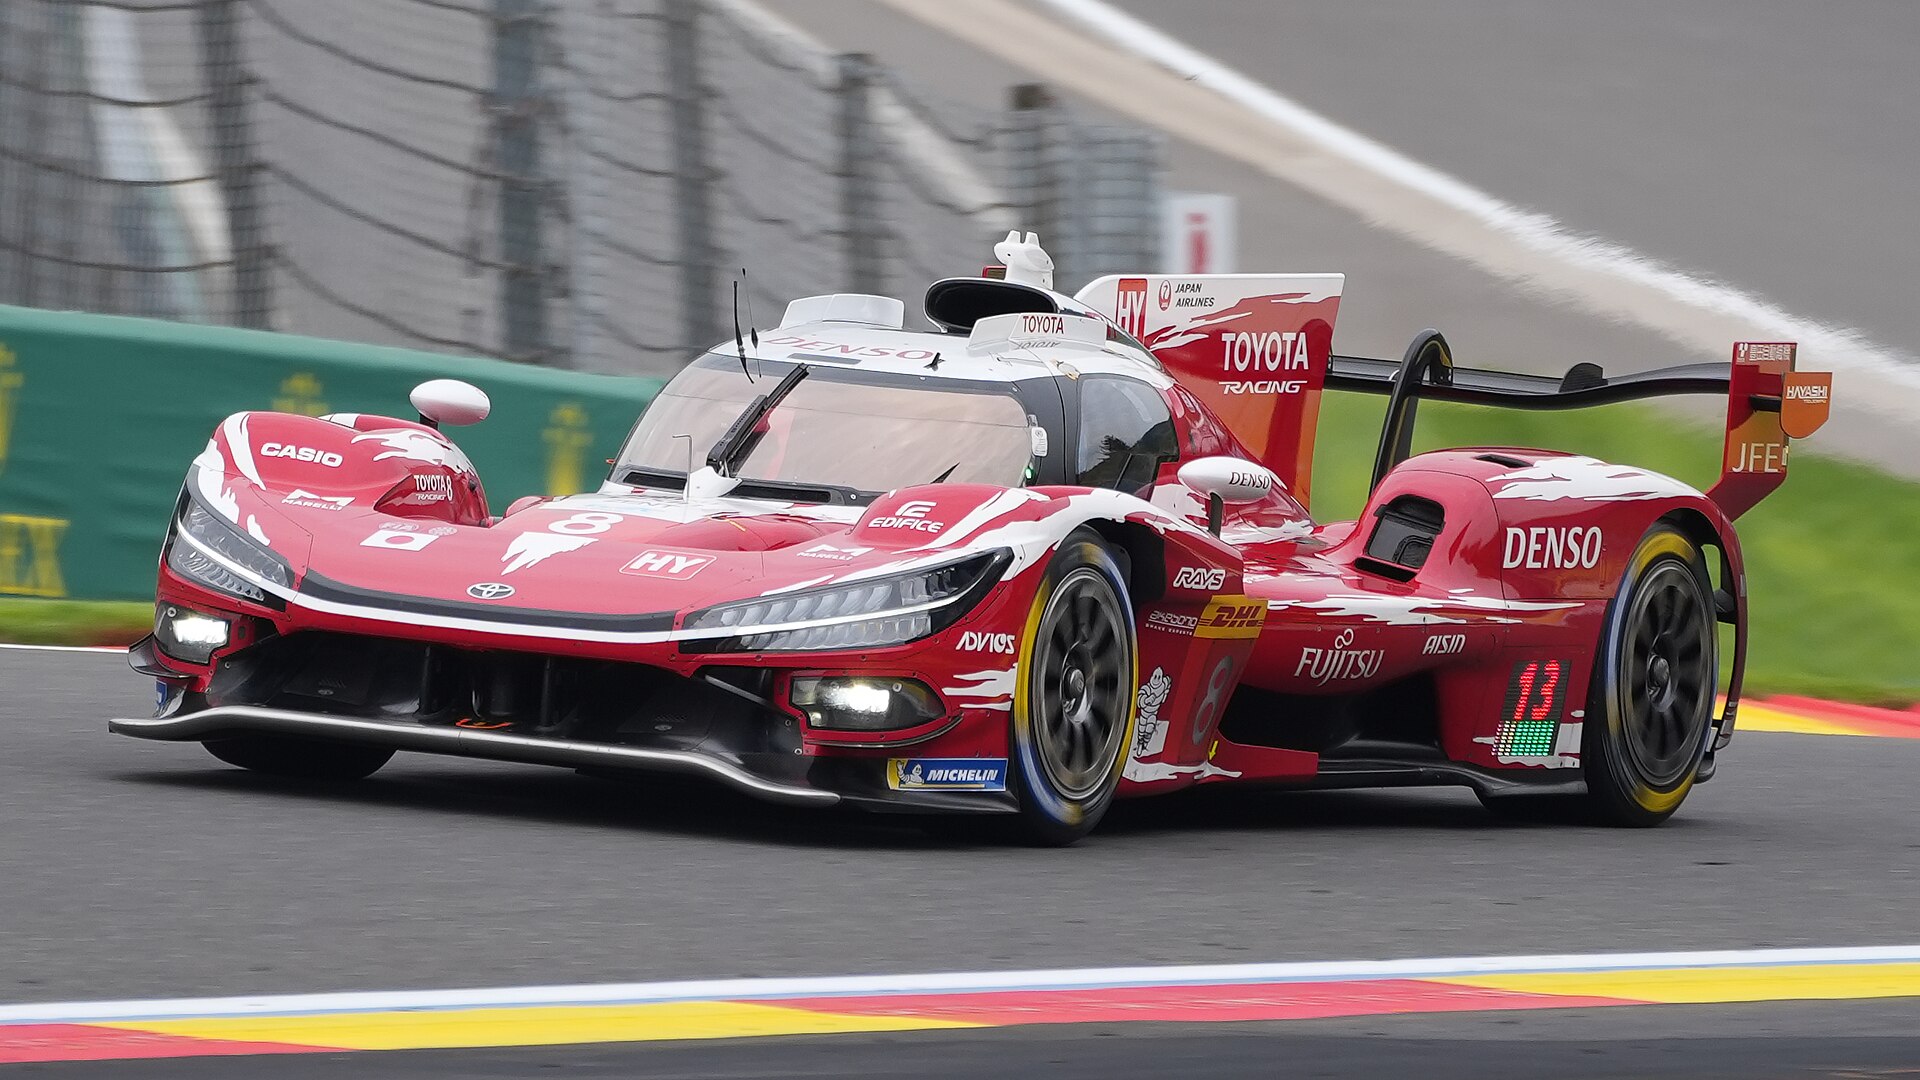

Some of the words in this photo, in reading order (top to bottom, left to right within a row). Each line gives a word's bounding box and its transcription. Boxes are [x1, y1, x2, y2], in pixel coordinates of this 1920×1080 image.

[1175, 283, 1203, 293] JAPAN
[1175, 297, 1215, 308] AIRLINES
[1023, 315, 1064, 334] TOYOTA
[763, 336, 934, 360] DENSO
[1221, 331, 1309, 372] TOYOTA
[1218, 380, 1308, 395] RACING
[1786, 385, 1828, 399] HAYASHI
[260, 442, 343, 468] CASIO
[1731, 442, 1780, 473] JFE
[413, 474, 446, 492] TOYOTA
[446, 475, 453, 501] 8
[1229, 471, 1270, 490] DENSO
[281, 499, 343, 512] MARELLI
[415, 493, 446, 501] RACING
[548, 512, 624, 535] 8
[868, 517, 944, 533] EDIFICE
[796, 552, 853, 561] MARELLI
[1503, 526, 1602, 569] DENSO
[629, 553, 707, 574] HY
[1173, 567, 1226, 590] RAYS
[1211, 605, 1262, 628] DHL
[1422, 634, 1466, 655] AISIN
[1293, 647, 1385, 687] FUJITSU
[1192, 655, 1234, 745] 8
[1513, 660, 1560, 722] 13
[926, 769, 999, 782] MICHELIN
